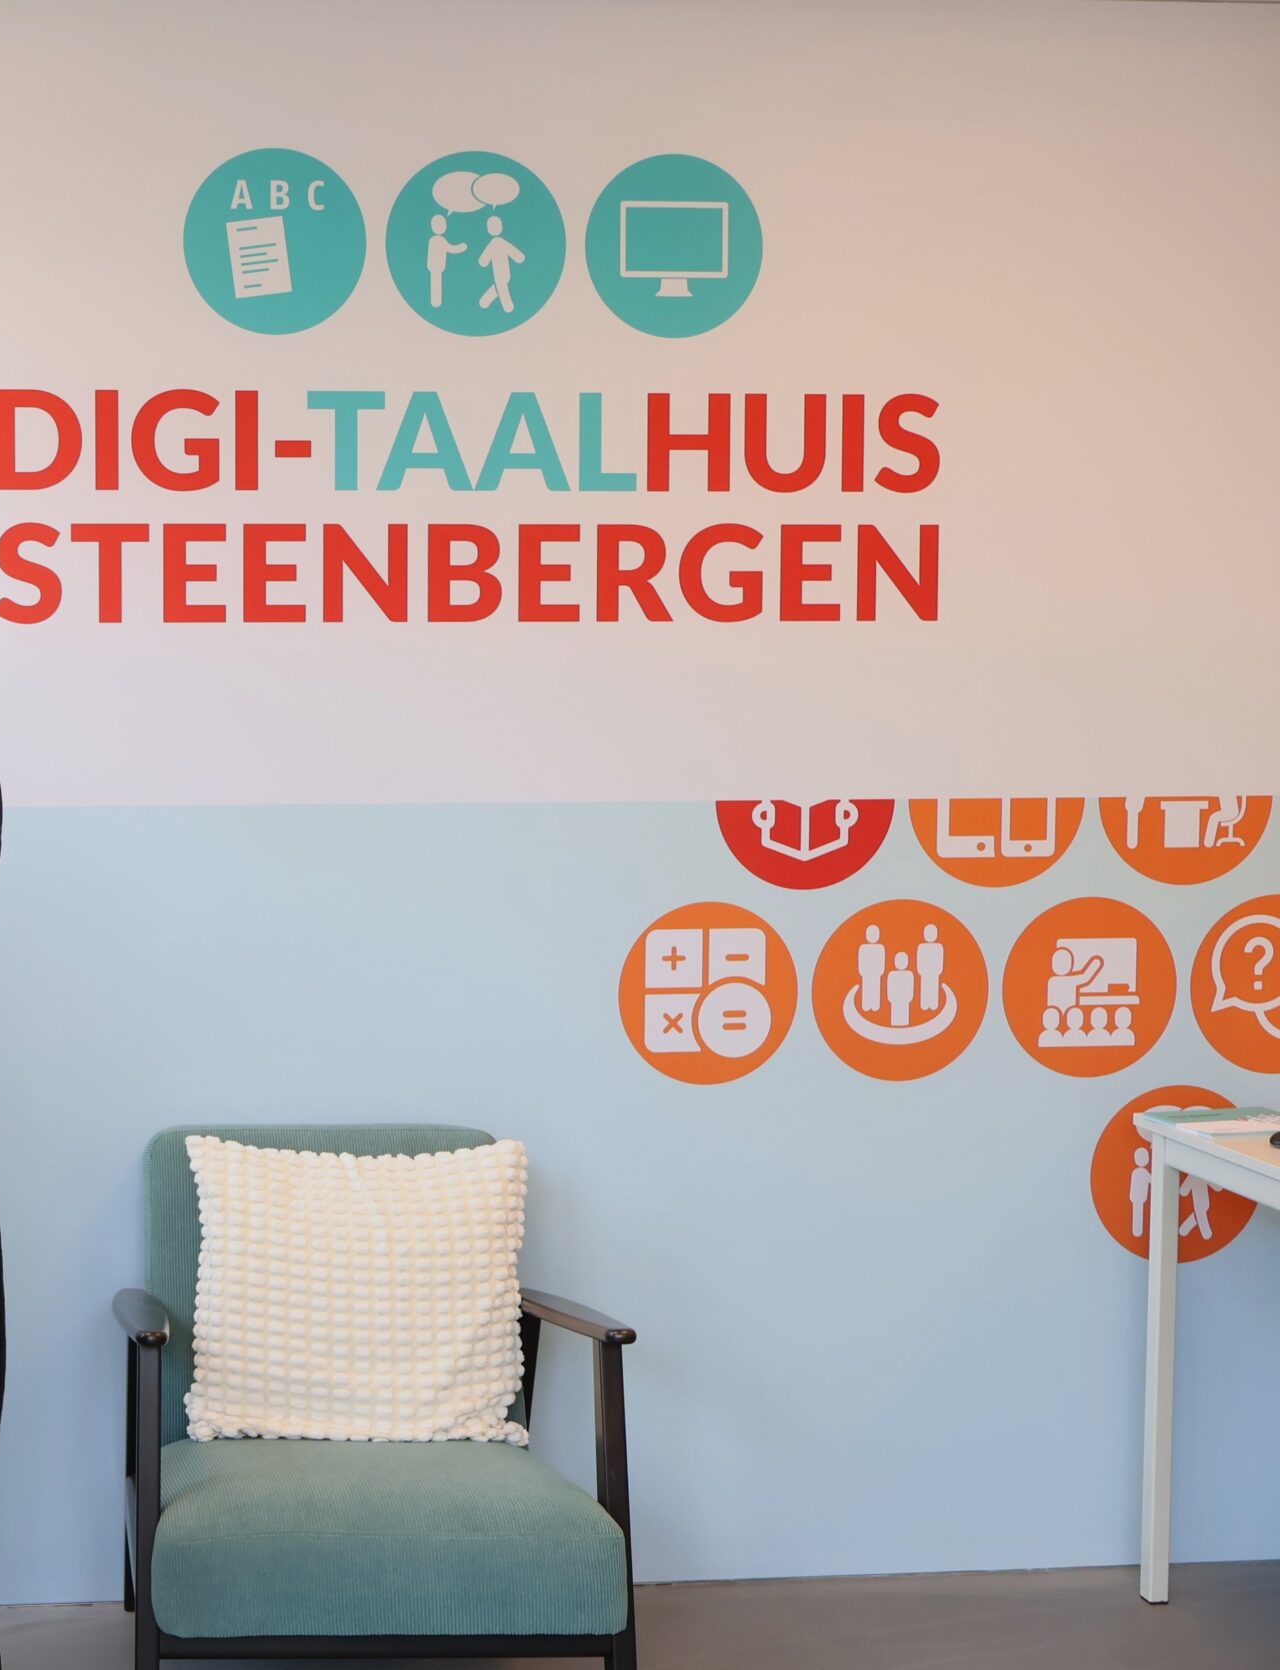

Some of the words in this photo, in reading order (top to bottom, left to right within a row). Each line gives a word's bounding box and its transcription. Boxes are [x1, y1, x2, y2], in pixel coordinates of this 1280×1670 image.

[231, 180, 254, 209] A
[270, 180, 290, 209] B
[307, 180, 326, 211] C
